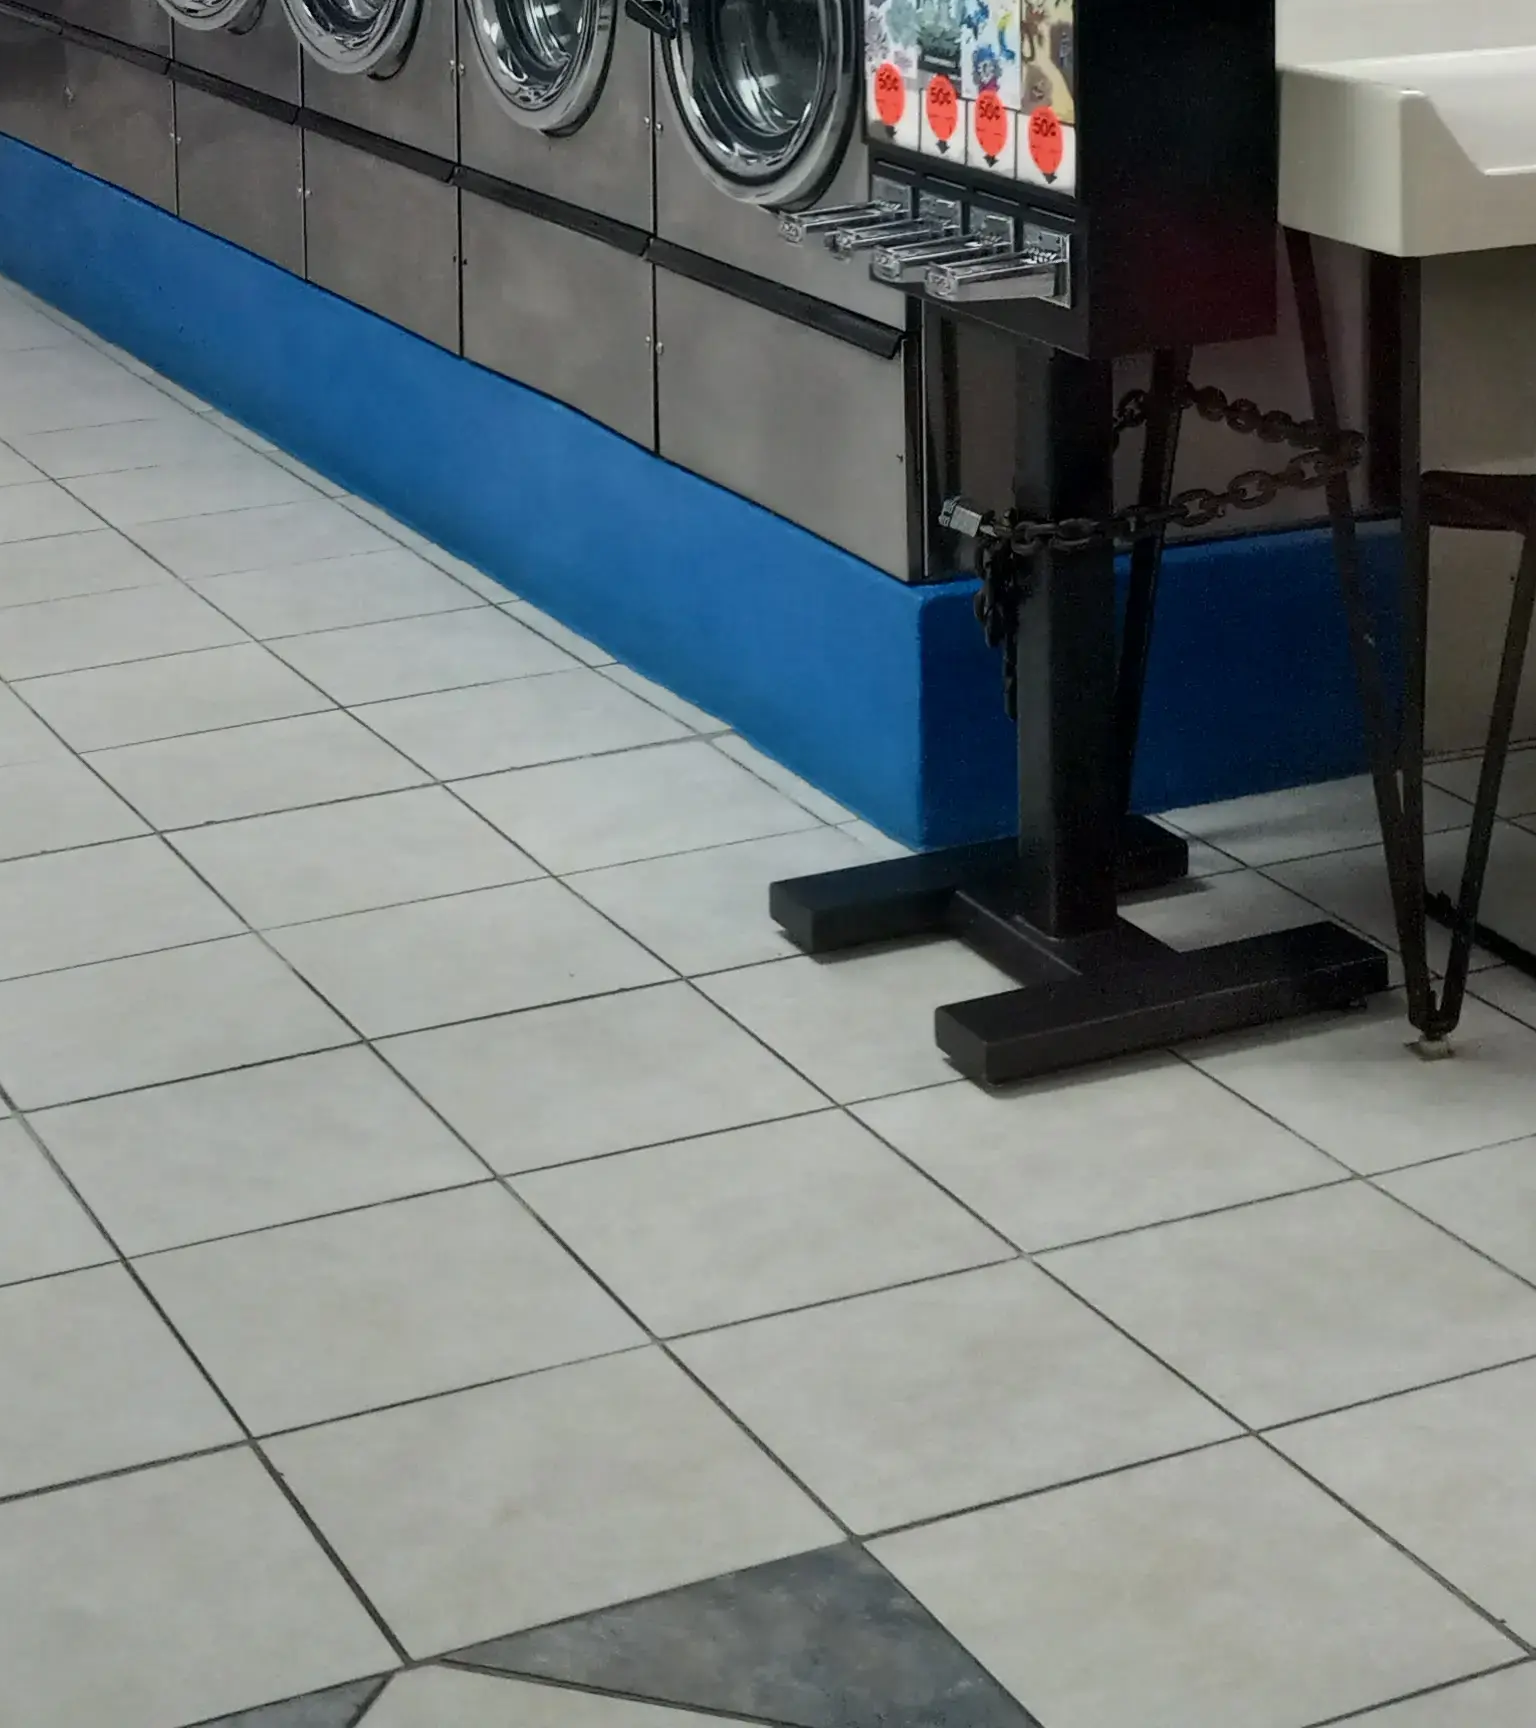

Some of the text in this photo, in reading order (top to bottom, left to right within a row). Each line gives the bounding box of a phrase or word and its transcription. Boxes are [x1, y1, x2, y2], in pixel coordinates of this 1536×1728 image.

[930, 86, 952, 106] 50¢
[978, 99, 1001, 121] 50¢
[1033, 117, 1057, 137] 50¢
